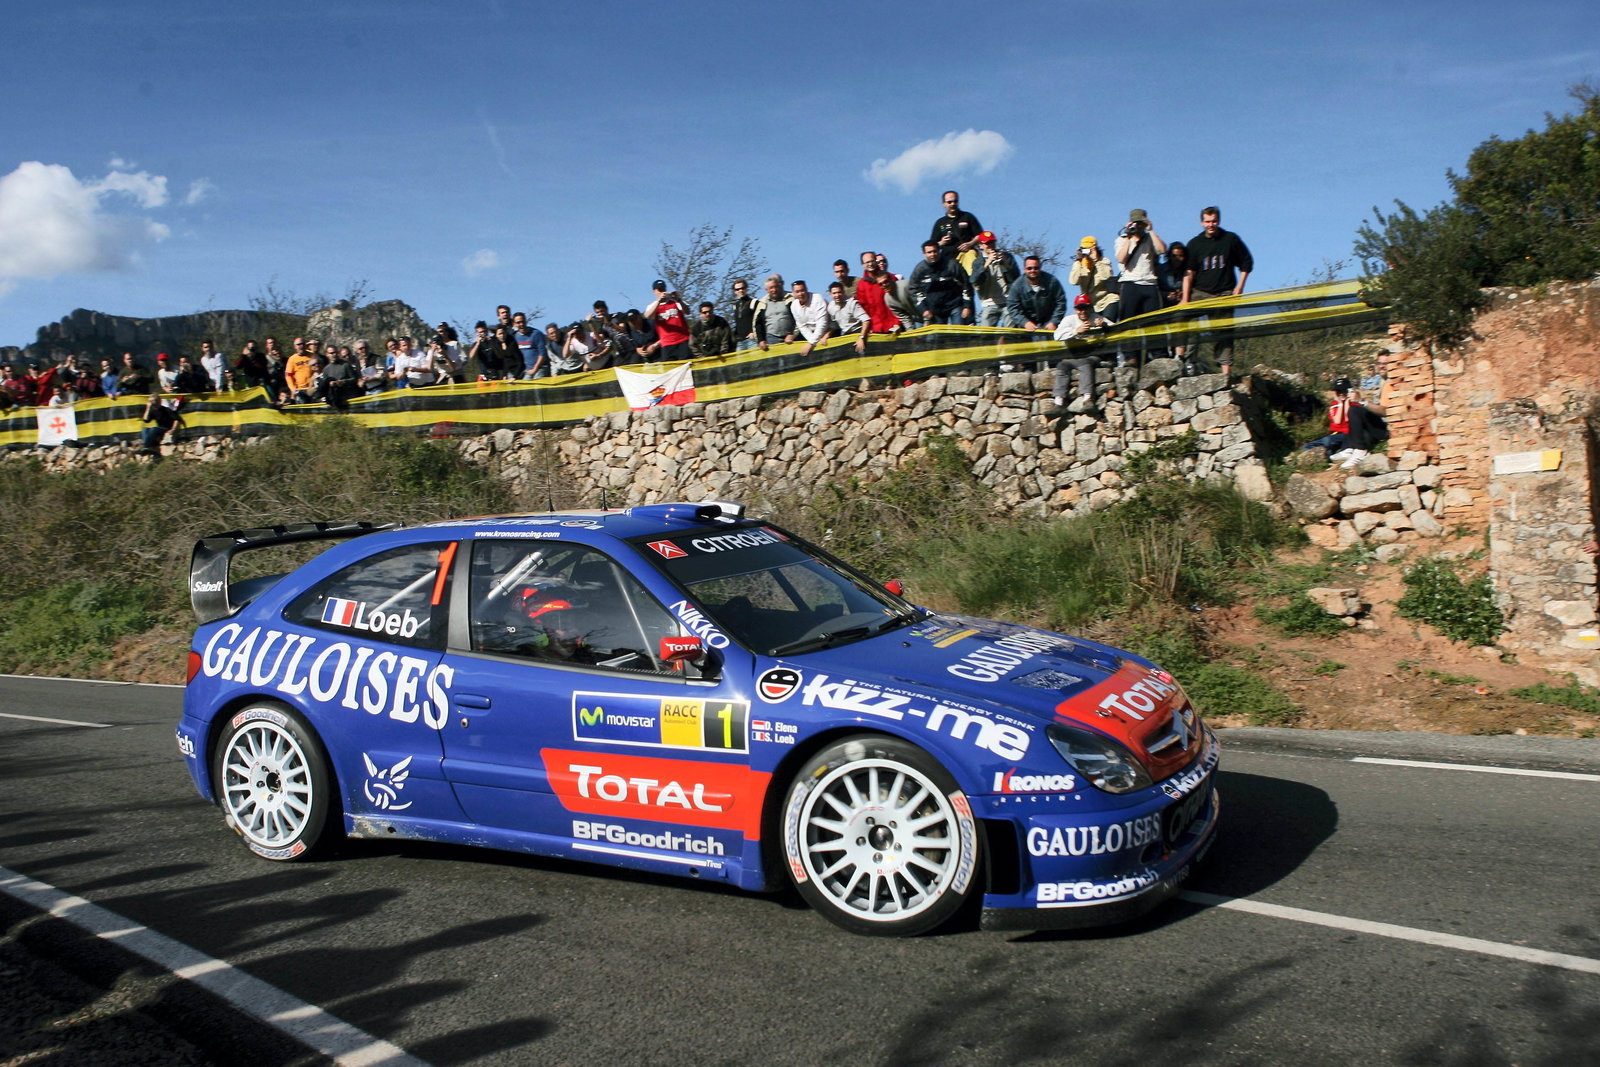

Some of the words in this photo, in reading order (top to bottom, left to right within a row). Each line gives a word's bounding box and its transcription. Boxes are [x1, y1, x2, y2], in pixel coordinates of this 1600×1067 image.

[474, 530, 561, 539] www.kronosracing.com
[193, 580, 224, 592] Sabelt
[431, 541, 458, 605] 1
[353, 600, 419, 638] Loeb
[669, 600, 730, 649] NIKKO
[665, 643, 703, 652] TOTAL
[202, 622, 455, 731] GAULOISES
[664, 704, 698, 718] RACC
[885, 687, 939, 703] NATURAL
[943, 700, 994, 717] ENERGY
[995, 714, 1036, 732] DRINK
[1098, 674, 1178, 721] TOTAL
[234, 710, 286, 727] BFGoodrich
[606, 714, 656, 728] movistar
[717, 703, 733, 749] 1
[765, 720, 773, 731] D.
[775, 721, 798, 734] Elena
[801, 674, 1031, 761] kizz-me
[764, 732, 773, 742] S.
[774, 733, 795, 745] Loeb
[568, 763, 723, 813] TOTAL
[993, 767, 1075, 794] KRONOS
[572, 819, 724, 857] BFGoodrich
[951, 796, 974, 891] BFGoodrich
[1026, 811, 1162, 857] GAULOISES
[1036, 867, 1159, 902] BFGoodrich
